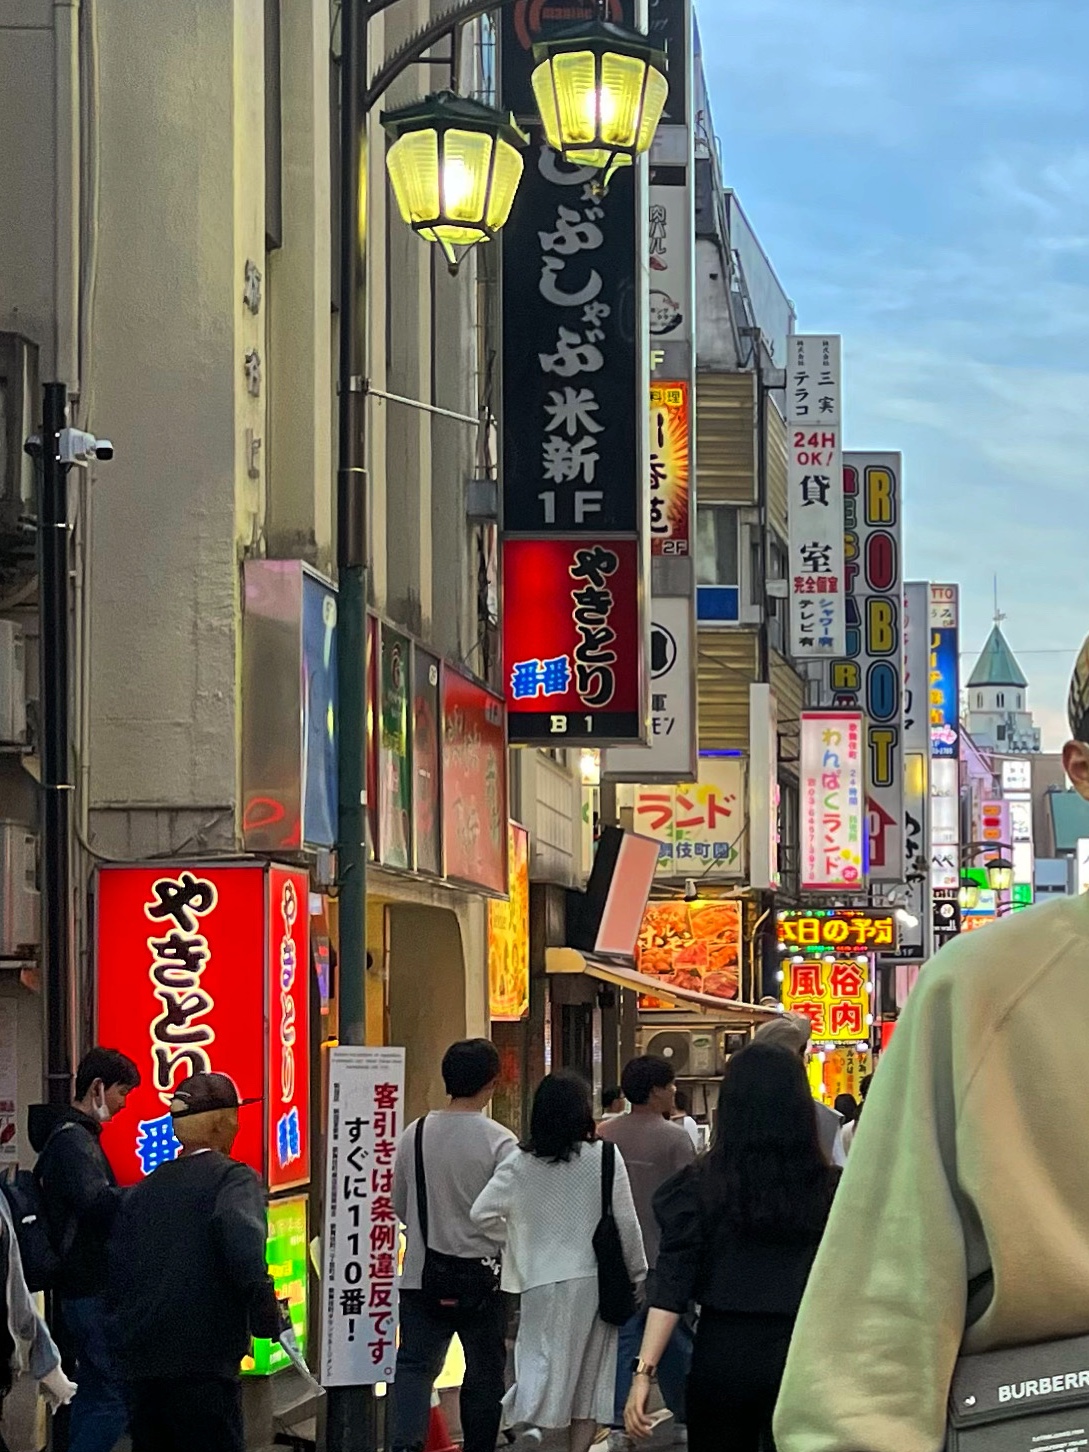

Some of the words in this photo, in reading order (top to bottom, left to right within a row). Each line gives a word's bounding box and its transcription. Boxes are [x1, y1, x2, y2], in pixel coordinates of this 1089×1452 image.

[793, 371, 809, 416] テラコ
[817, 371, 835, 414] 三実
[793, 431, 836, 448] 24H
[796, 451, 834, 467] OK!
[538, 490, 604, 524] 1F
[661, 540, 687, 555] 2F
[568, 545, 619, 708] やきとり
[864, 464, 899, 787] ROBOT
[637, 793, 737, 831] ランド
[147, 871, 217, 1106] やきとり
[278, 877, 299, 1104] やきとり
[788, 963, 865, 998] 風俗
[367, 1082, 399, 1376] 客引きは条例違反です。
